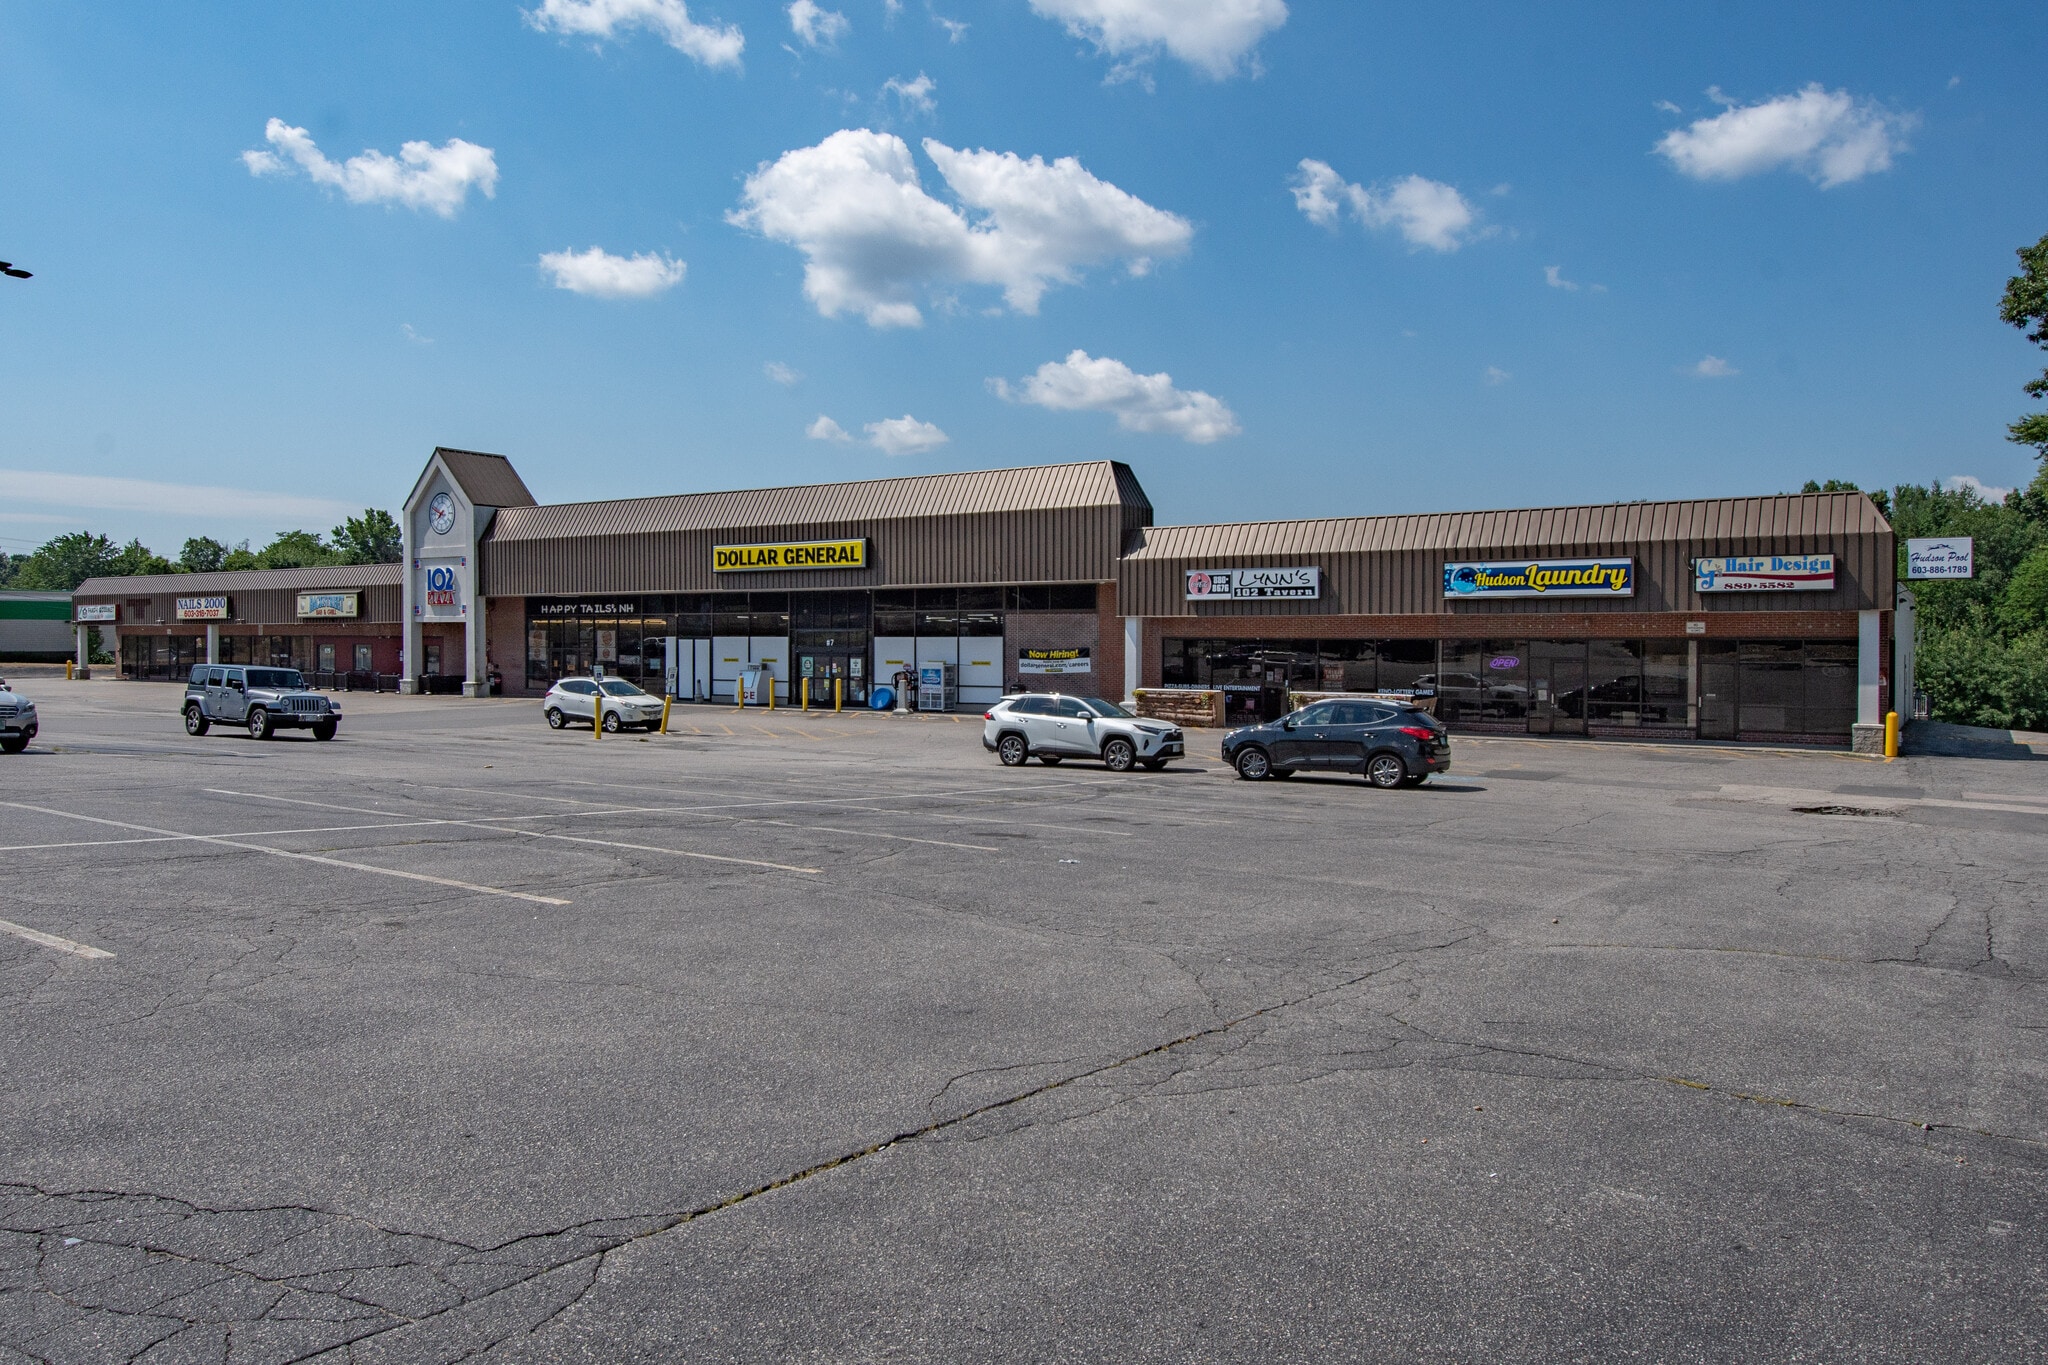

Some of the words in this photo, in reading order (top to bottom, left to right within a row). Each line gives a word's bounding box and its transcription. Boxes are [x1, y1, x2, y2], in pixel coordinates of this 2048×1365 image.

[717, 548, 778, 567] DOLLAR
[783, 545, 859, 565] GENERAL
[1911, 552, 1944, 562] Hudson
[1948, 551, 1969, 562] Pool
[1725, 557, 1764, 572] Hair
[1771, 555, 1831, 574] Design
[1911, 565, 1968, 574] 603-886-1789
[427, 567, 454, 591] 102
[1474, 572, 1527, 587] Hudson
[1524, 562, 1628, 593] Laundry
[1235, 588, 1259, 597] 102
[1264, 586, 1313, 597] Tavern
[177, 599, 202, 609] NAILS
[204, 597, 226, 609] 2000
[427, 590, 455, 605] PLAZA
[541, 605, 577, 613] HAPPY
[618, 603, 634, 613] NH
[1028, 649, 1048, 659] Now
[1049, 648, 1079, 659] Hiring!
[1492, 658, 1517, 668] OPEN
[1415, 688, 1434, 696] GAMES
